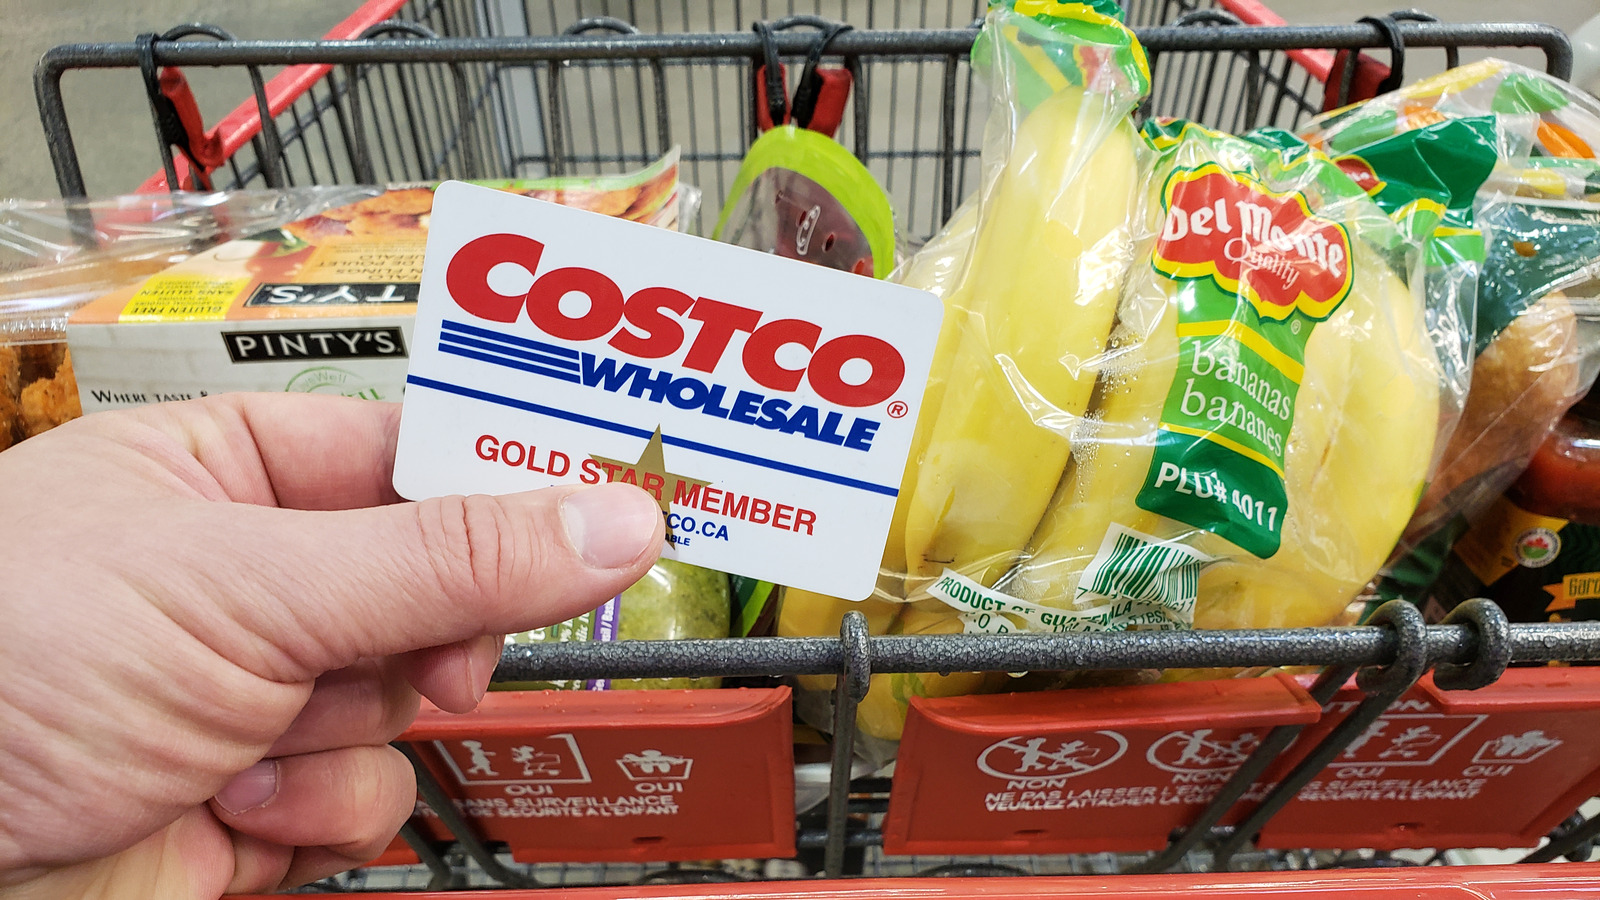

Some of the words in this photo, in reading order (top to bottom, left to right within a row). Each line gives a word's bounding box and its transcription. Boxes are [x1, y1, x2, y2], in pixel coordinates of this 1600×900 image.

[1161, 197, 1233, 242] Del
[1235, 201, 1344, 278] Monte
[1224, 237, 1300, 290] Quality
[266, 284, 406, 304] TY'S
[131, 306, 165, 314] FREE
[169, 305, 222, 313] GLUTEN
[446, 233, 906, 408] COSTCO
[234, 331, 396, 357] PINTY'S
[1191, 340, 1291, 421] bananas
[580, 352, 880, 452] WHOLESALE
[1179, 378, 1282, 457] bananes
[475, 434, 571, 478] GOLD
[579, 458, 665, 500] STAR
[673, 479, 817, 536] MEMBER
[1231, 489, 1278, 532] 4011
[662, 511, 729, 541] CO.CA
[935, 576, 1006, 611] PRODUCT
[1011, 605, 1036, 615] OF
[1171, 771, 1232, 784] NON
[1336, 767, 1385, 779] OUI
[1462, 764, 1514, 777] OUI
[505, 784, 553, 796] OUI
[635, 782, 683, 794] OUI
[985, 792, 1016, 803] NE
[1020, 790, 1062, 801] PAS
[1067, 786, 1157, 801] LAISSER
[1007, 779, 1067, 790] NON
[513, 794, 676, 808] SURVEILLANCE
[985, 800, 1065, 811] VEUILLEZ
[1067, 797, 1156, 809] ATTACHER
